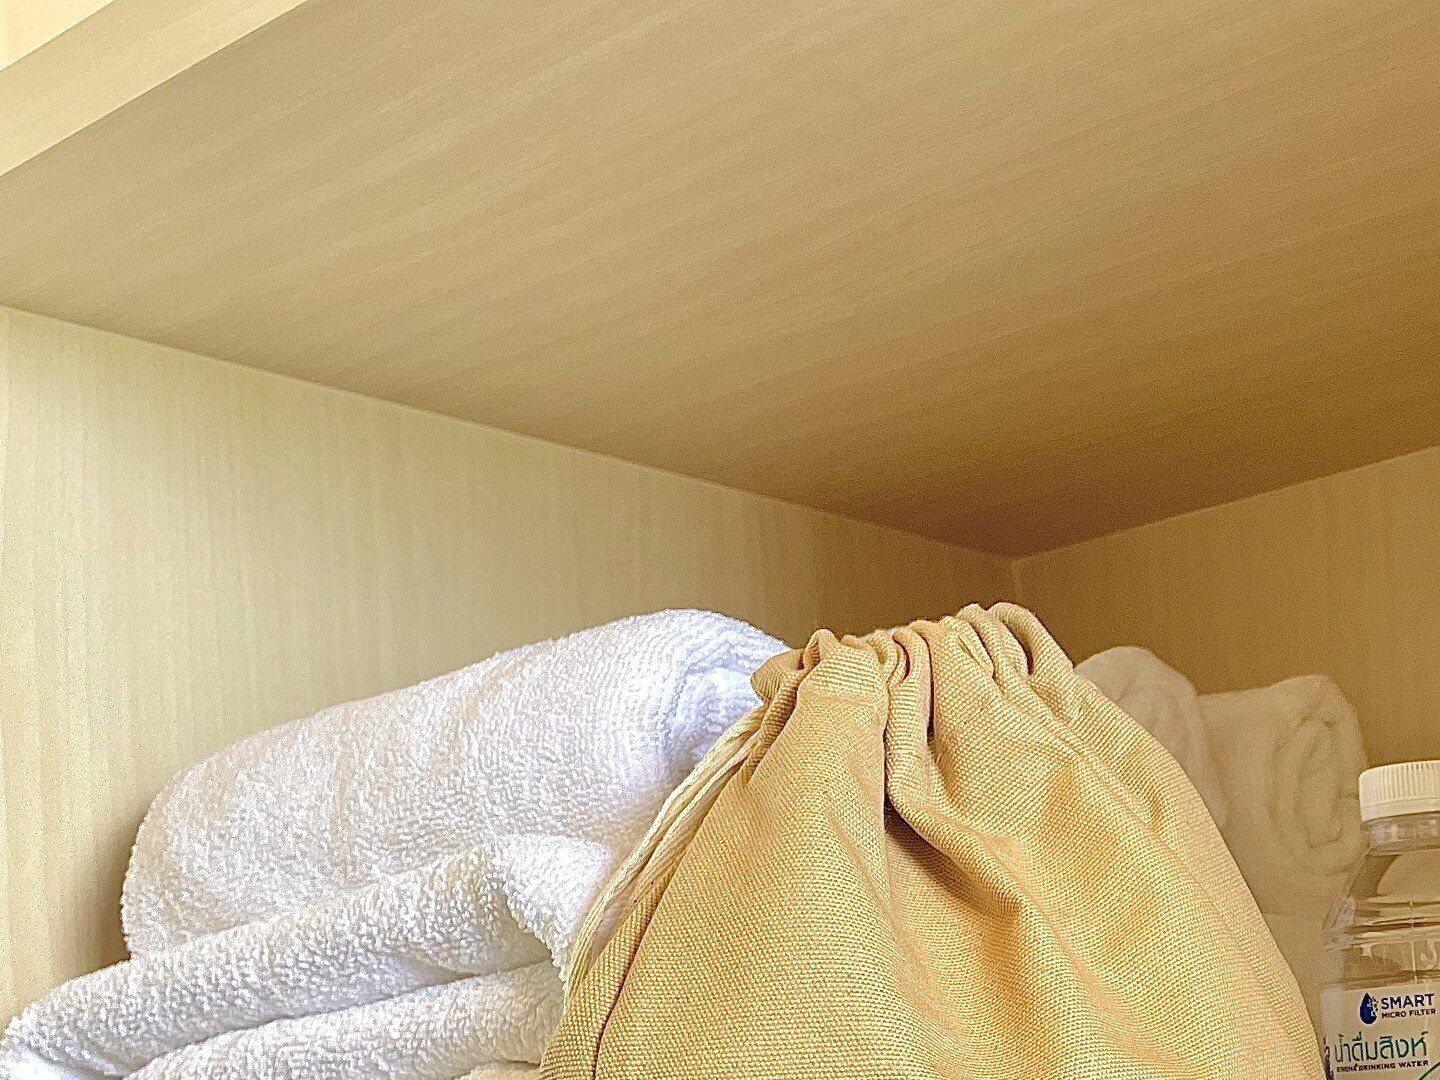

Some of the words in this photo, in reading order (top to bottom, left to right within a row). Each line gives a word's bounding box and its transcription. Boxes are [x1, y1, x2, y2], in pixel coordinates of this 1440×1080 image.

[1381, 993, 1435, 1010] SMART
[1381, 1011, 1407, 1019] MICRO
[1409, 1008, 1436, 1017] FILTER
[1334, 1031, 1429, 1062] น้ำดื่มสิงห์
[1358, 1062, 1396, 1071] DRINKING
[1399, 1060, 1429, 1069] WATER
